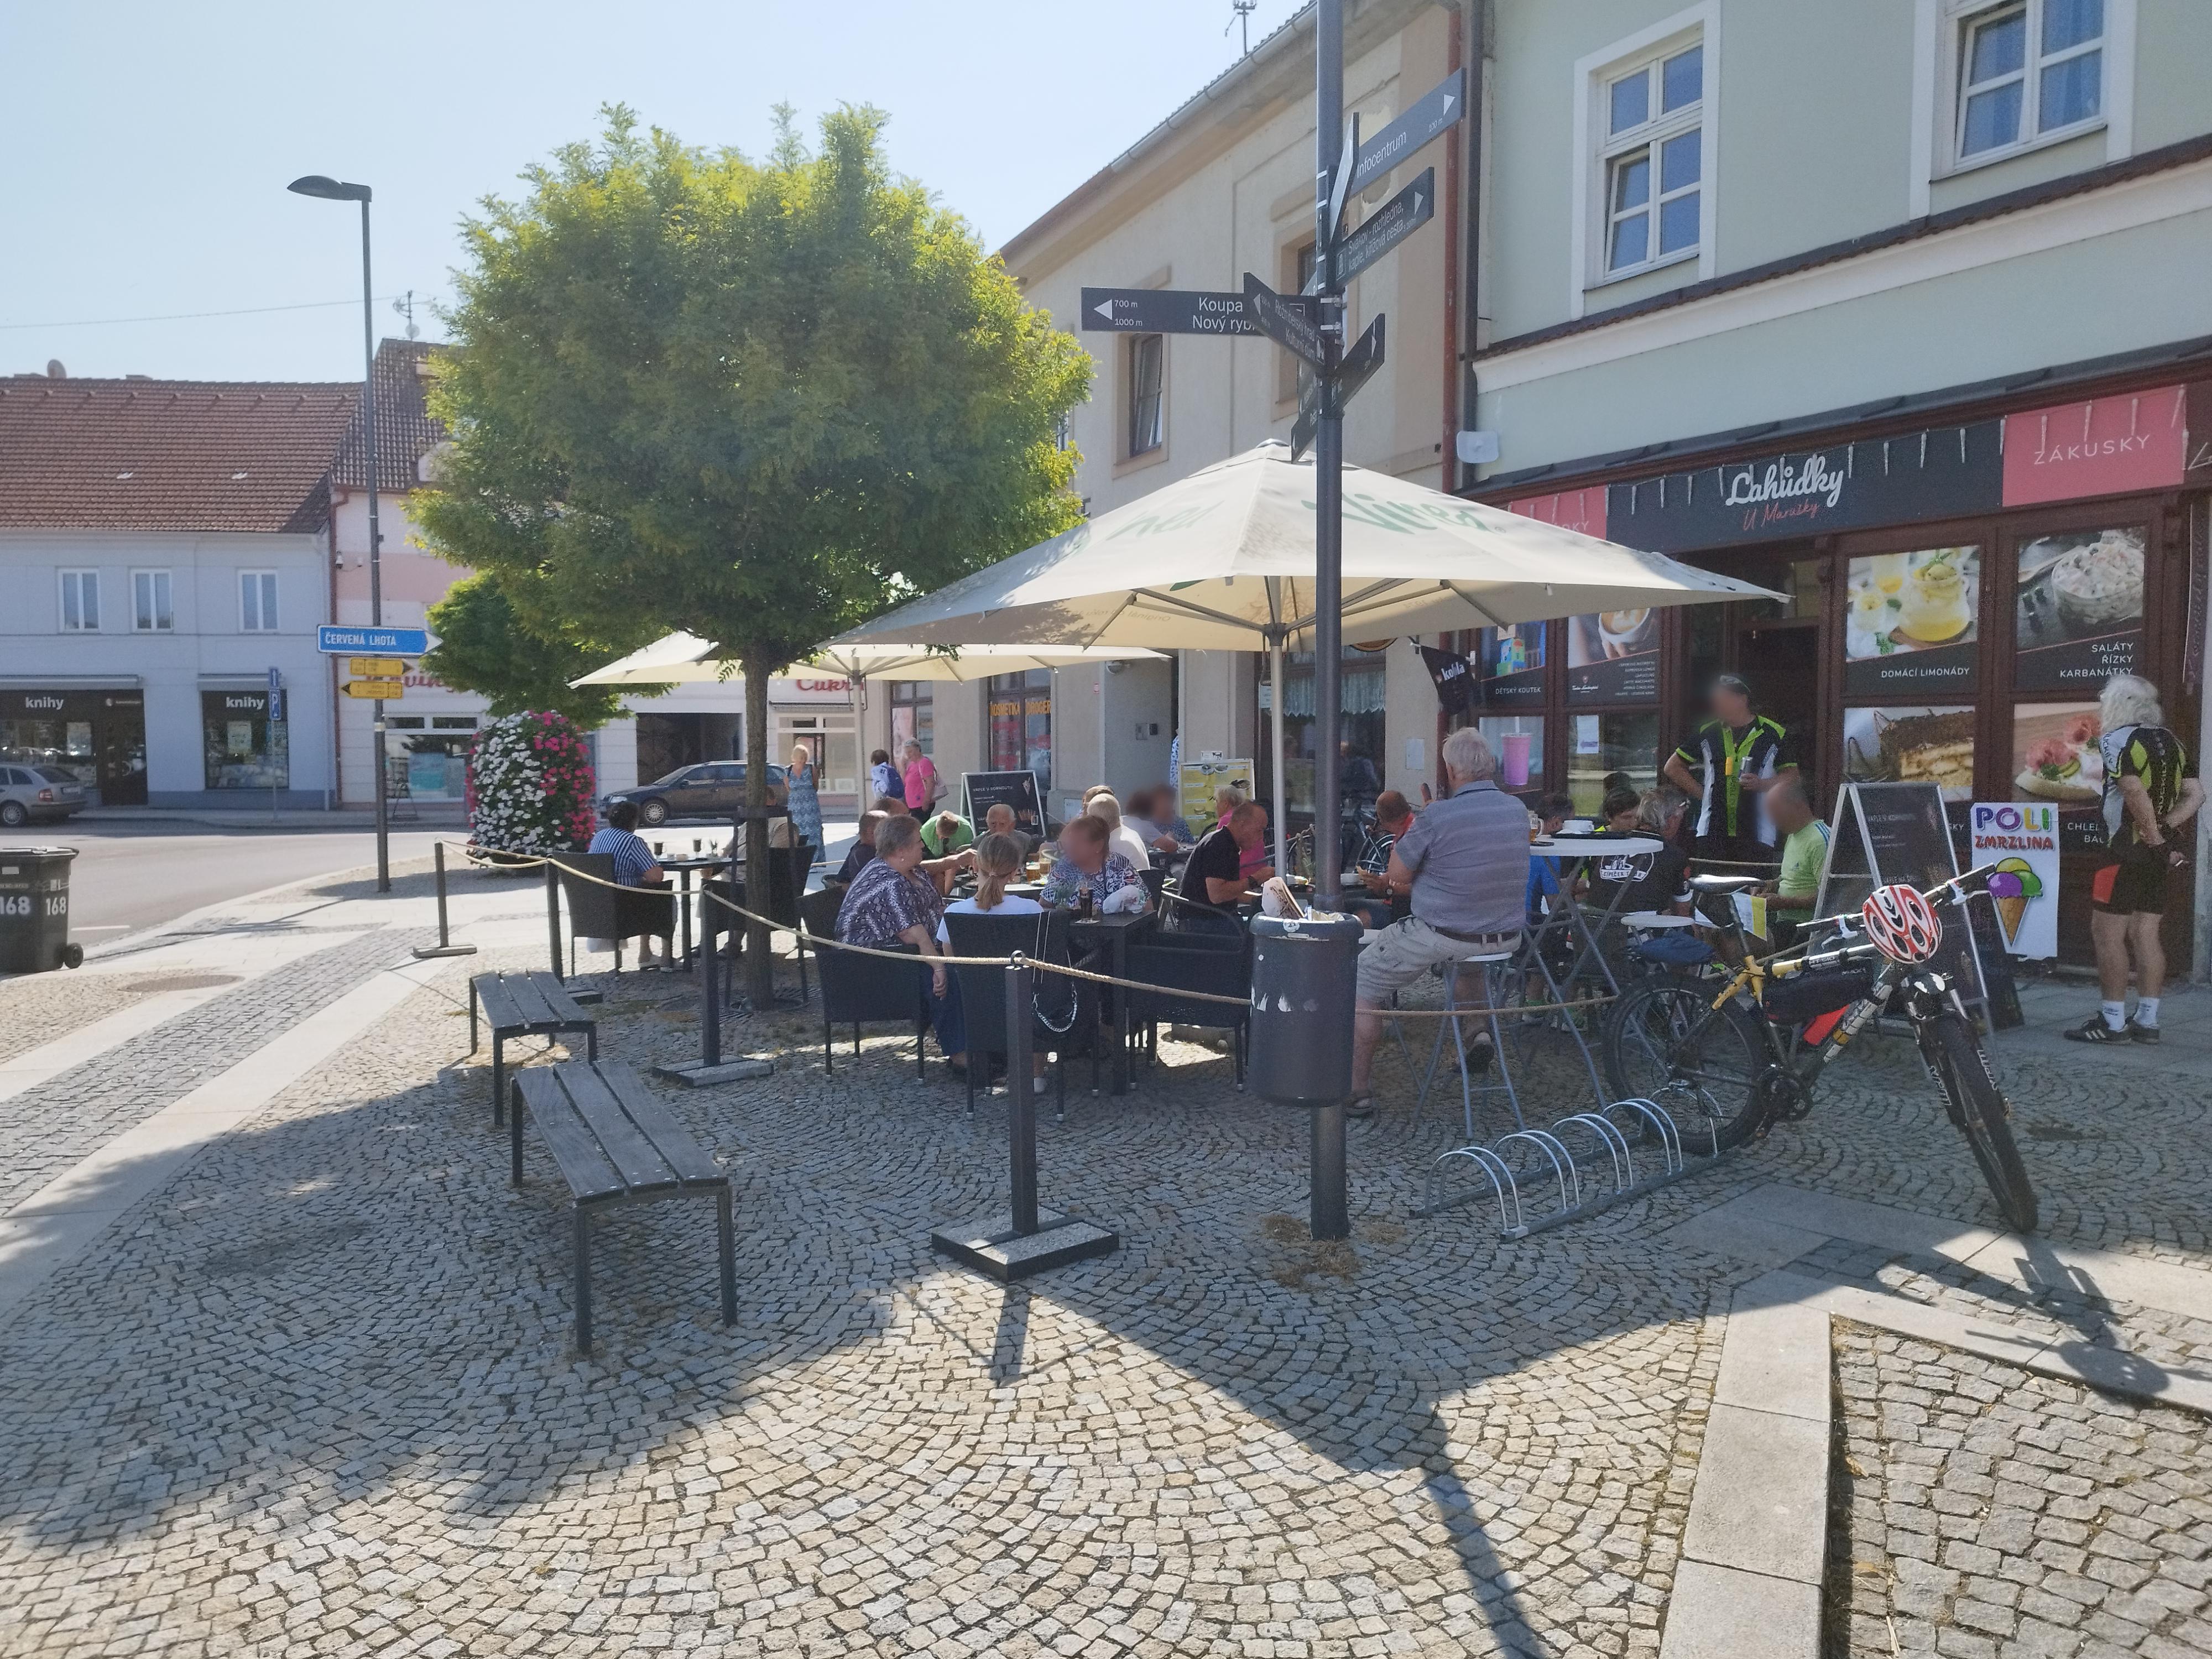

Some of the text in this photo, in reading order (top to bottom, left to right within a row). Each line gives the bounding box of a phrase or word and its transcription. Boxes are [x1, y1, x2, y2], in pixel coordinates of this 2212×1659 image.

[1357, 131, 1407, 179] Infocentrum
[1373, 202, 1404, 236] rozhledna,
[1198, 297, 1243, 312] Koupa
[1192, 316, 1226, 333] Nový
[2034, 435, 2150, 465] ZÁKUSKY
[1725, 456, 1844, 507] Lahůdky
[325, 632, 397, 646] ČERVENÁ LHOTA
[2091, 641, 2134, 653] SALÁTY
[2102, 654, 2133, 665] ŘÍZKY
[1881, 666, 1970, 678] DOMÁCÍ LIMONÁDY
[2060, 665, 2133, 678] KARBANÁTKY
[796, 679, 864, 691] Cukr
[25, 697, 64, 710] knihy
[226, 697, 264, 710] knihy
[1975, 807, 2052, 831] POLI
[1974, 834, 2054, 850] ZMRZLINA
[0, 896, 30, 915] 168
[46, 896, 66, 915] 168
